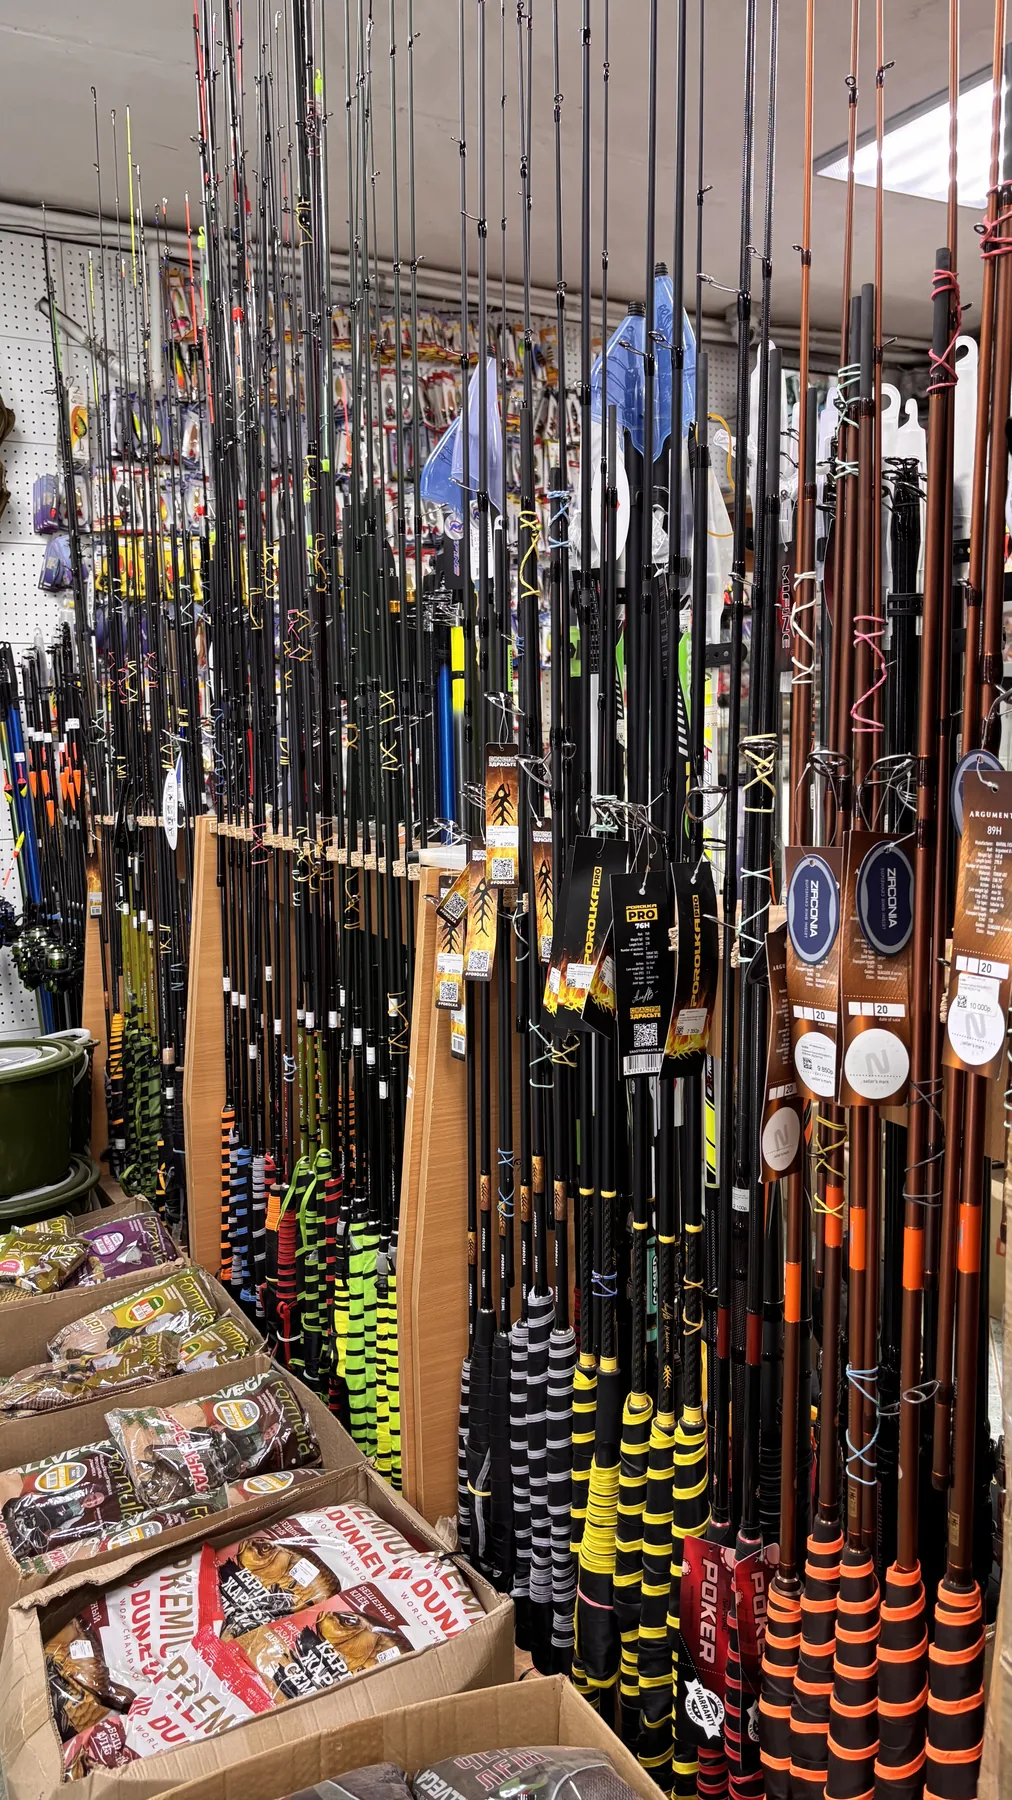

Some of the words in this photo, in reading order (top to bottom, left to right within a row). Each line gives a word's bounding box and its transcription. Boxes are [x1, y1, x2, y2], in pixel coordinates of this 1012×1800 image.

[987, 826, 1002, 836] 89H
[584, 888, 600, 965] POROLKA
[593, 867, 602, 886] PRO
[628, 910, 656, 920] PRO
[810, 880, 818, 937] ZIRCONIA
[887, 868, 897, 928] ZIRCONIA
[690, 918, 701, 1007] POROLKA
[981, 962, 992, 973] 20
[816, 1011, 825, 1020] 20
[877, 1005, 888, 1014] 20
[270, 1380, 310, 1456] Formula
[358, 1585, 396, 1622] БЕШЕНЫЙ
[400, 1592, 428, 1626] WORLD
[698, 1558, 719, 1664] POKER
[694, 1686, 716, 1728] WARRANTY
[415, 1769, 467, 1800] LVEGA
